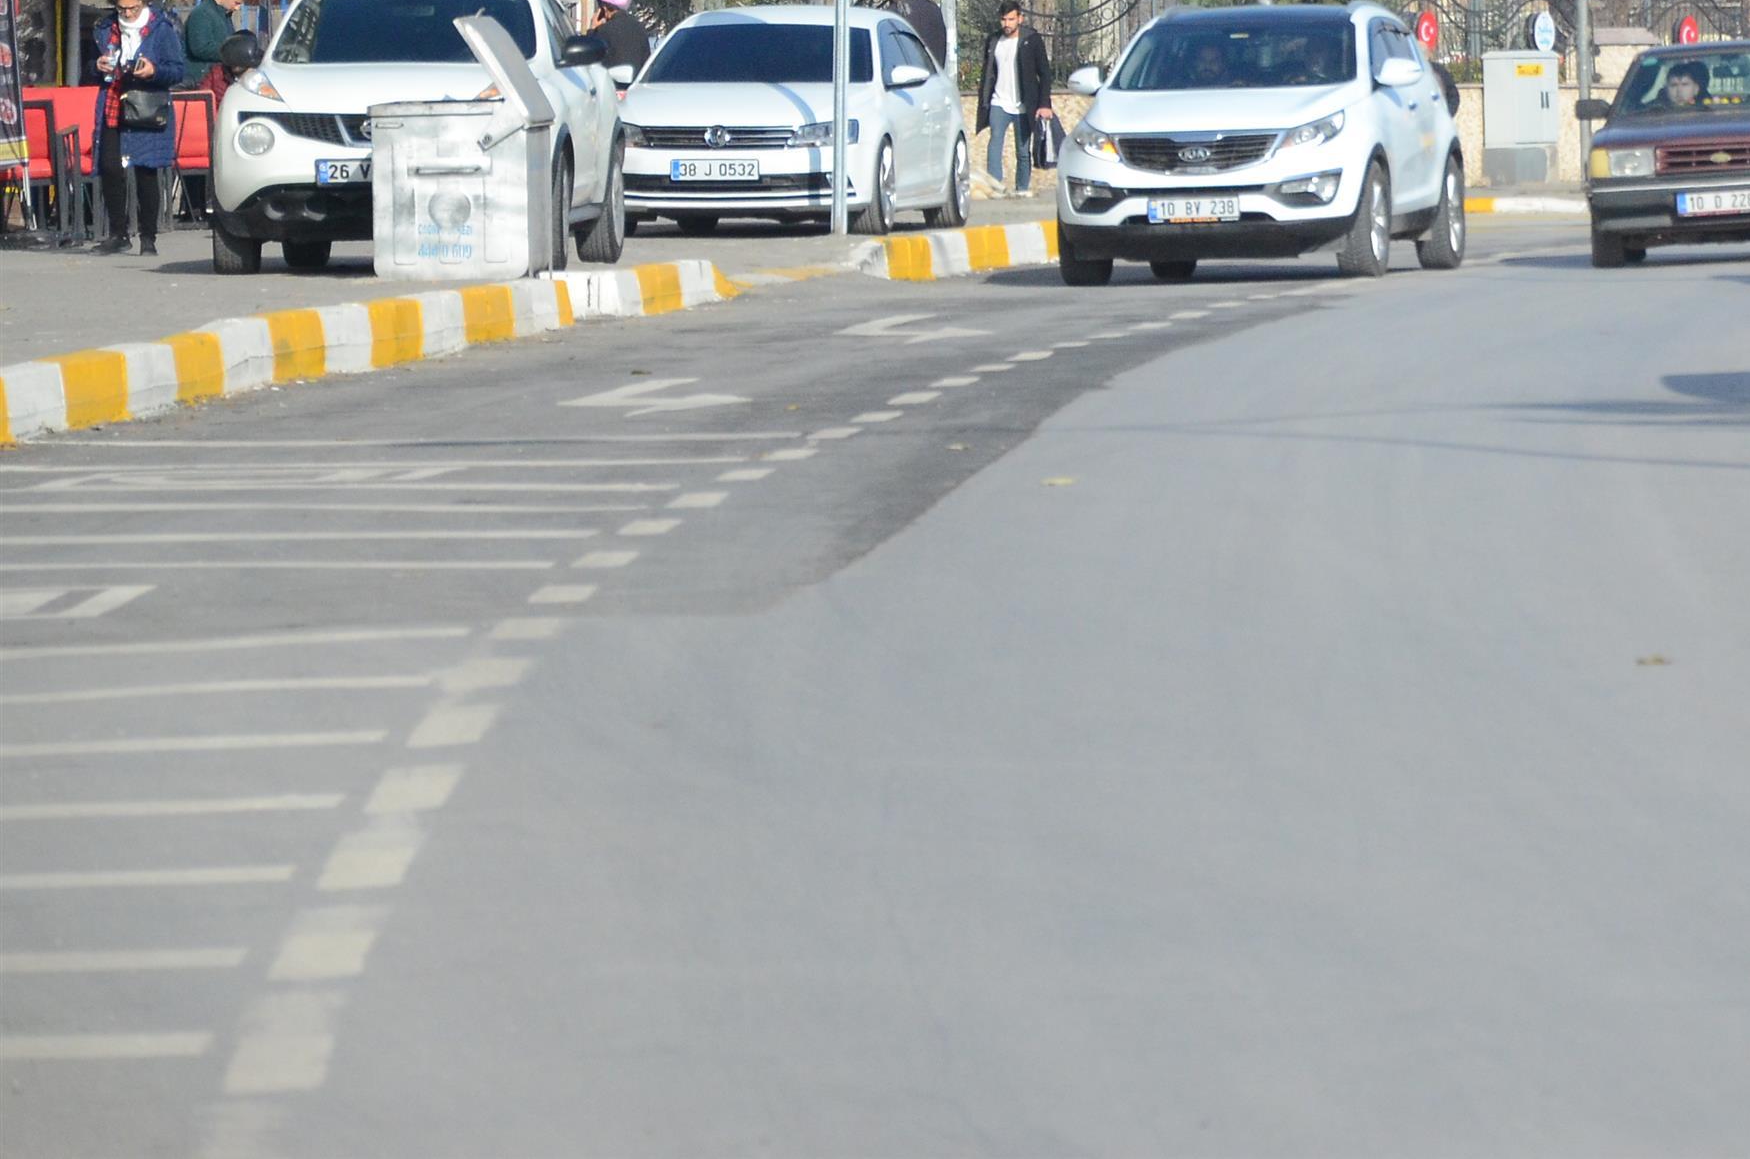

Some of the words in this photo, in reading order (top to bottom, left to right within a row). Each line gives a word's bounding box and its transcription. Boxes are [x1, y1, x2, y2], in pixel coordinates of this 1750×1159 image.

[329, 164, 349, 180] 26
[680, 163, 697, 176] 38
[704, 163, 712, 176] J
[719, 163, 755, 176] 0532
[1161, 202, 1175, 216] 10
[1210, 200, 1234, 215] 238
[1690, 197, 1704, 210] 10
